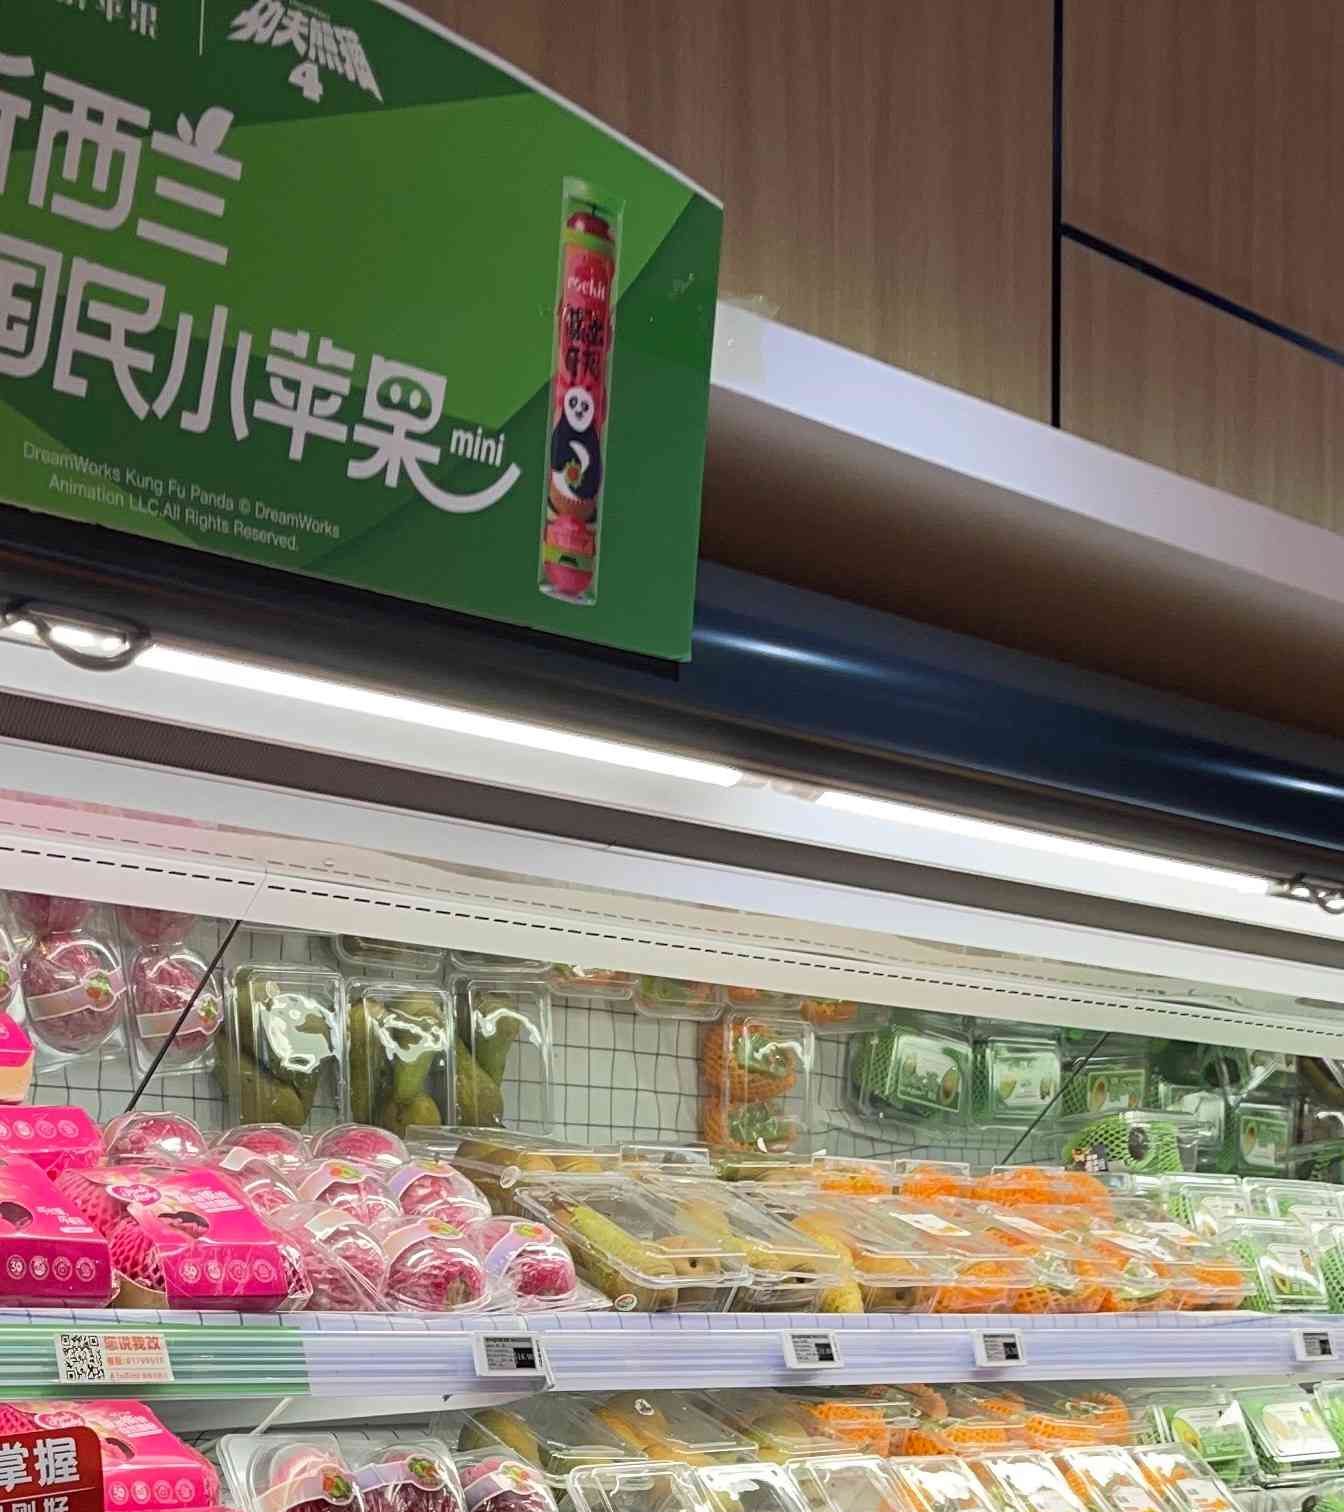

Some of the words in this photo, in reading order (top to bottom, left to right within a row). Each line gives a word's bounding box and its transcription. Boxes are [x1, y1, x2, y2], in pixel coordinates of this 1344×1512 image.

[288, 61, 323, 103] 4
[450, 425, 506, 468] mini
[23, 442, 121, 482] DreamWorks
[126, 469, 163, 497] Kung
[168, 479, 186, 498] Fu
[191, 484, 234, 512] Panda
[255, 502, 341, 538] DreamWorks
[49, 474, 124, 507] Animation
[185, 509, 229, 534] Rights
[233, 520, 299, 551] Reserved.
